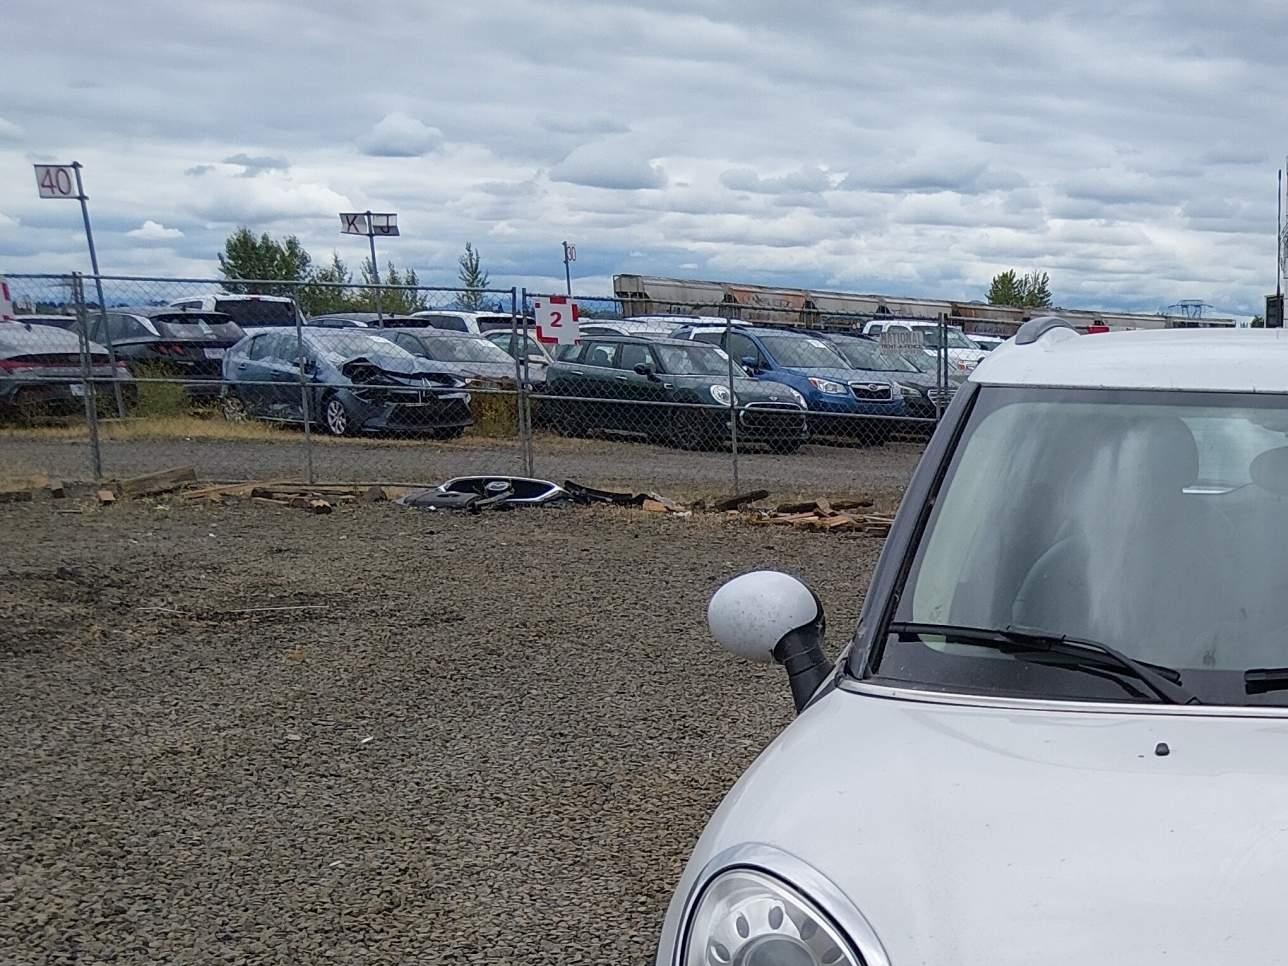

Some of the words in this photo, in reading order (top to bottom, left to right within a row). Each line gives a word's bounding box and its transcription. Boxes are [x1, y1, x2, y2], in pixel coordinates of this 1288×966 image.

[41, 168, 72, 195] 40
[345, 215, 360, 233] K
[380, 215, 390, 233] J
[550, 311, 563, 328] 2
